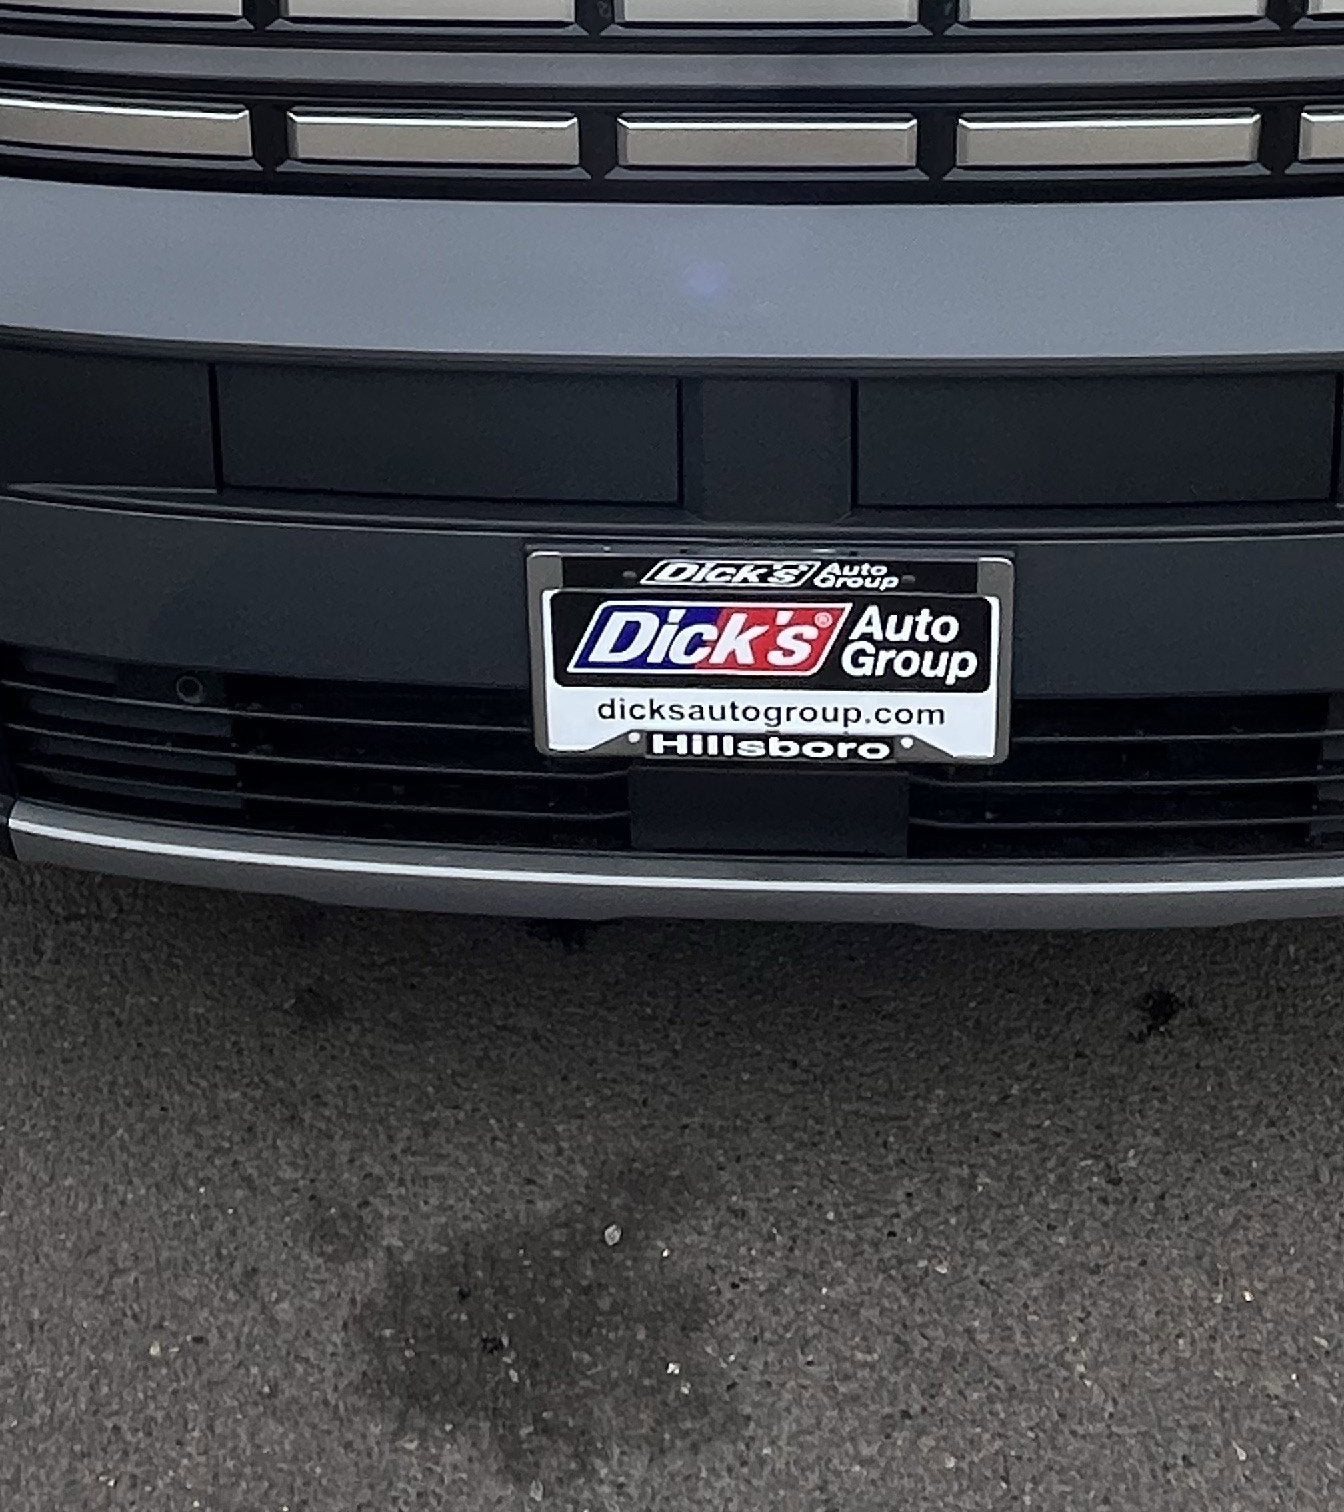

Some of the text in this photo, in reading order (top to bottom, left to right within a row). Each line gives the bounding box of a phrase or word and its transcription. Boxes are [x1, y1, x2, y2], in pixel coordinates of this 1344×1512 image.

[813, 573, 900, 591] Group
[821, 562, 888, 576] Auto
[850, 605, 960, 643] Auto
[840, 641, 978, 686] Group
[597, 698, 946, 728] dicksautogroup.com
[652, 733, 891, 760] Hillsboro
